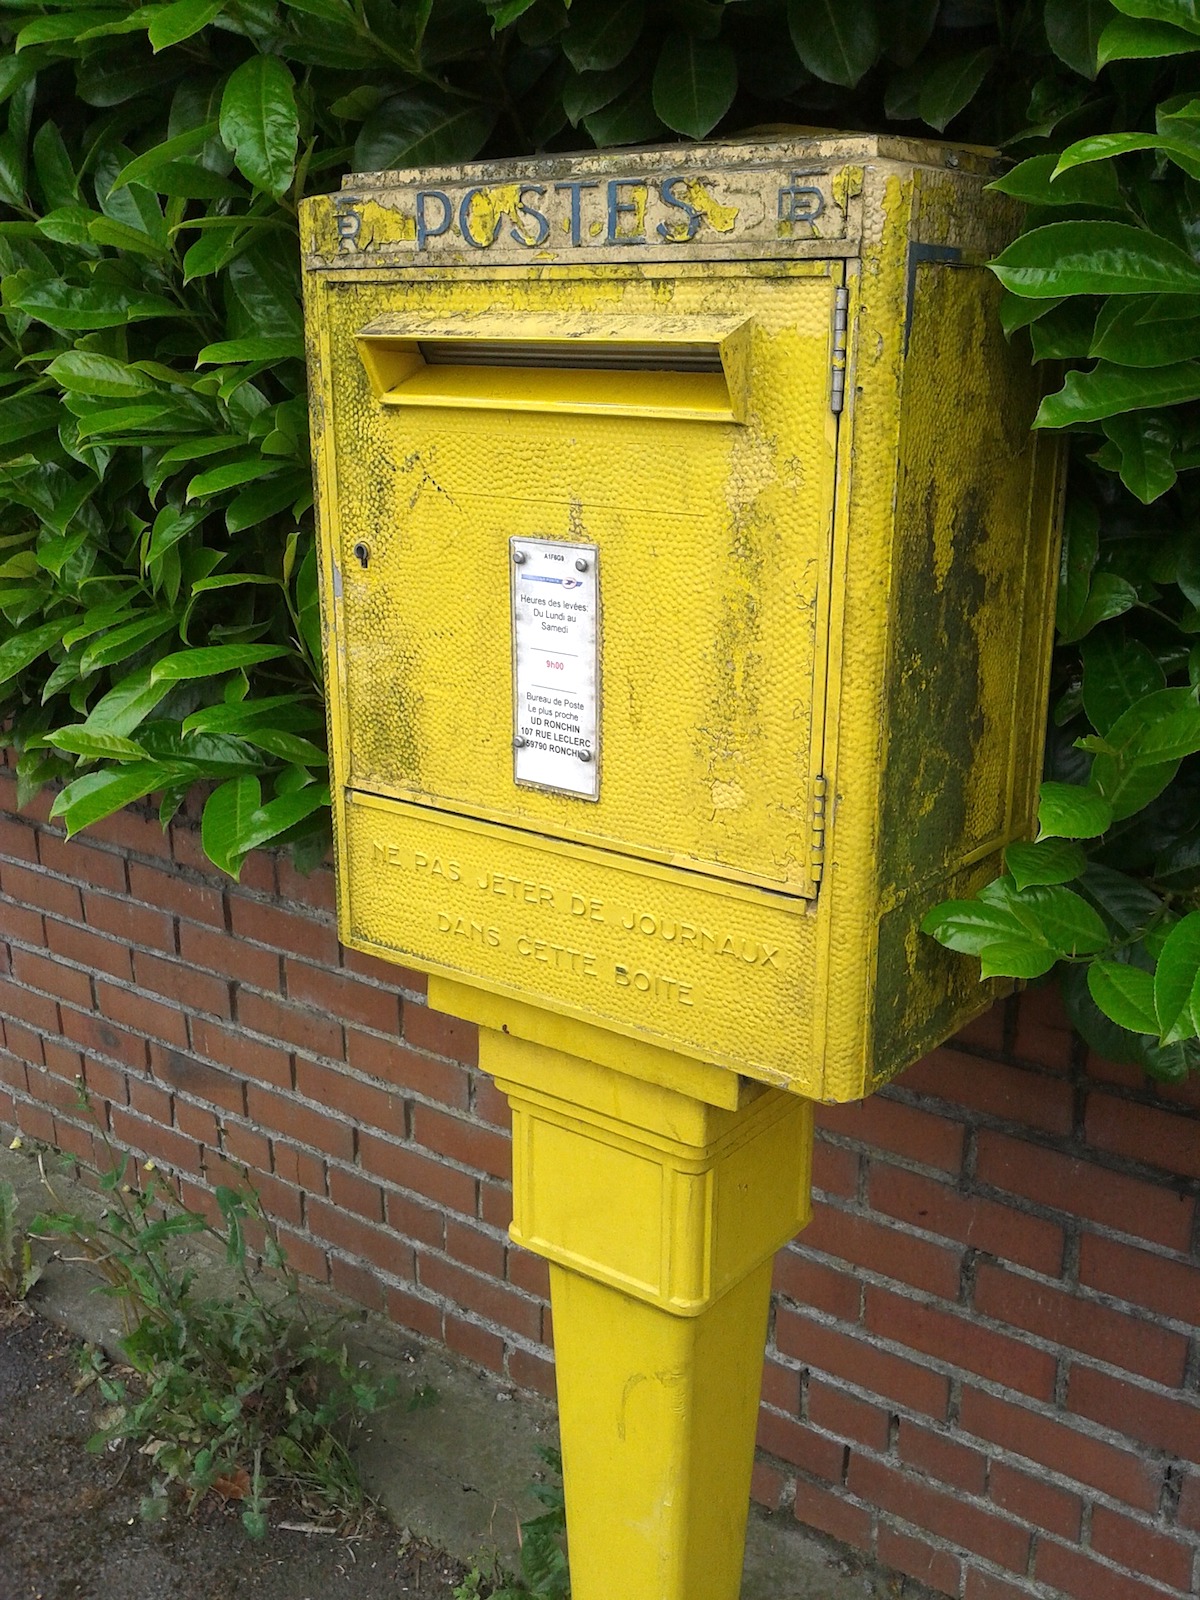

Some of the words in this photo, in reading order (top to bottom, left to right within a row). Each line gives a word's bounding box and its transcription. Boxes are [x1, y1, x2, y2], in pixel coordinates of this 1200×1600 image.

[416, 176, 700, 250] POSTES
[520, 594, 546, 606] Heures
[548, 599, 561, 608] des
[533, 608, 544, 618] Du
[545, 610, 565, 620] Lundi
[541, 622, 569, 634] Samedi
[546, 660, 564, 670] 9h00
[526, 692, 552, 704] Bureau
[553, 698, 562, 706] de
[564, 699, 584, 711] Poste
[528, 704, 537, 713] Le
[538, 706, 553, 717] plus
[554, 711, 579, 722] proche
[530, 717, 542, 726] UD
[544, 719, 580, 734] RONCHIN
[521, 727, 533, 735] 107
[535, 730, 552, 740] RUE
[554, 733, 591, 748] LECLERC
[526, 740, 548, 751] 59790
[549, 744, 581, 758] RONCHI
[373, 841, 401, 867] NE
[415, 851, 460, 882] PAS
[477, 872, 555, 909] JETER
[571, 893, 605, 922] DE
[621, 912, 780, 969] JOURNAUX
[438, 912, 500, 947] DANS
[517, 935, 597, 976] CETTE
[615, 963, 694, 1006] BOITE
